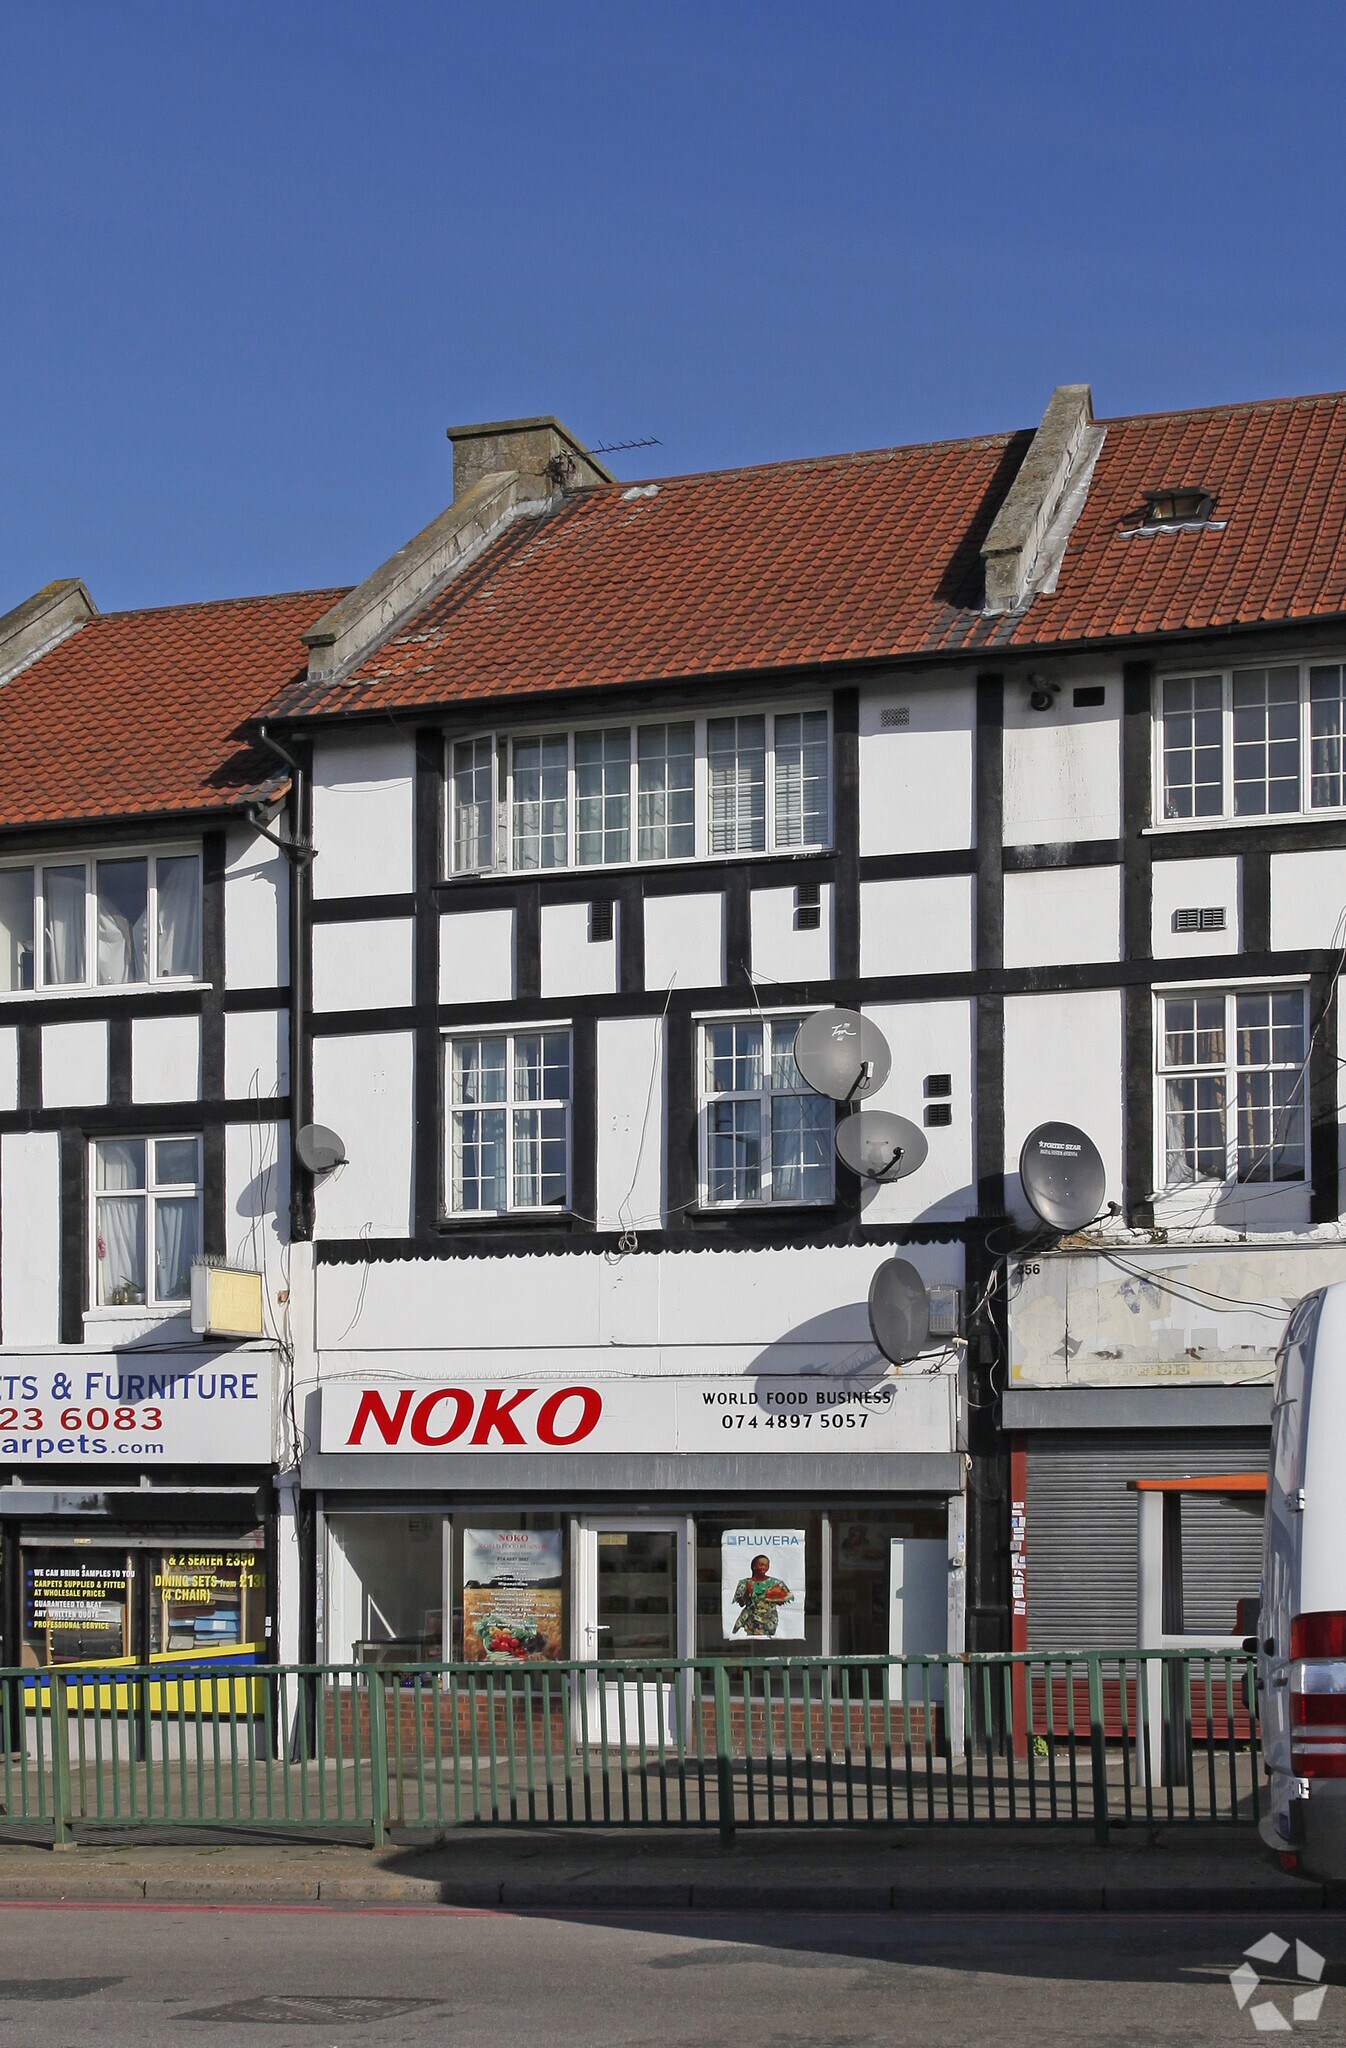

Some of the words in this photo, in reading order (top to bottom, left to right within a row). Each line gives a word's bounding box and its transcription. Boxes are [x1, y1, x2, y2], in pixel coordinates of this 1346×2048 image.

[0, 1374, 38, 1400] TS
[51, 1372, 72, 1400] &
[85, 1372, 258, 1400] FURNITURE
[702, 1392, 758, 1405] WORLD
[766, 1392, 808, 1405] FOOD
[816, 1391, 891, 1404] BUSINESS
[60, 1407, 163, 1431] 6083
[345, 1386, 602, 1446] NOKO
[722, 1415, 758, 1428] 074
[765, 1414, 813, 1428] 4897
[820, 1414, 868, 1428] 5057
[499, 1534, 529, 1542] NOKO
[738, 1535, 799, 1546] PLUVERA
[179, 1554, 185, 1566] 2
[188, 1554, 223, 1566] SEATER
[34, 1569, 45, 1577] WE
[46, 1569, 59, 1577] CAN
[60, 1569, 80, 1577] BRING
[82, 1570, 111, 1578] SAMPLES
[112, 1570, 121, 1578] TO
[104, 1581, 126, 1589] FITTED
[155, 1574, 189, 1588] DINING
[192, 1574, 217, 1588] SETS
[220, 1579, 237, 1588] from
[82, 1590, 106, 1598] PRICES
[175, 1589, 211, 1603] CHAIR)
[86, 1601, 102, 1609] BEAT
[48, 1610, 77, 1618] WRITTEN
[34, 1621, 80, 1629] PROFESSIONAL
[82, 1621, 109, 1630] SERVICE
